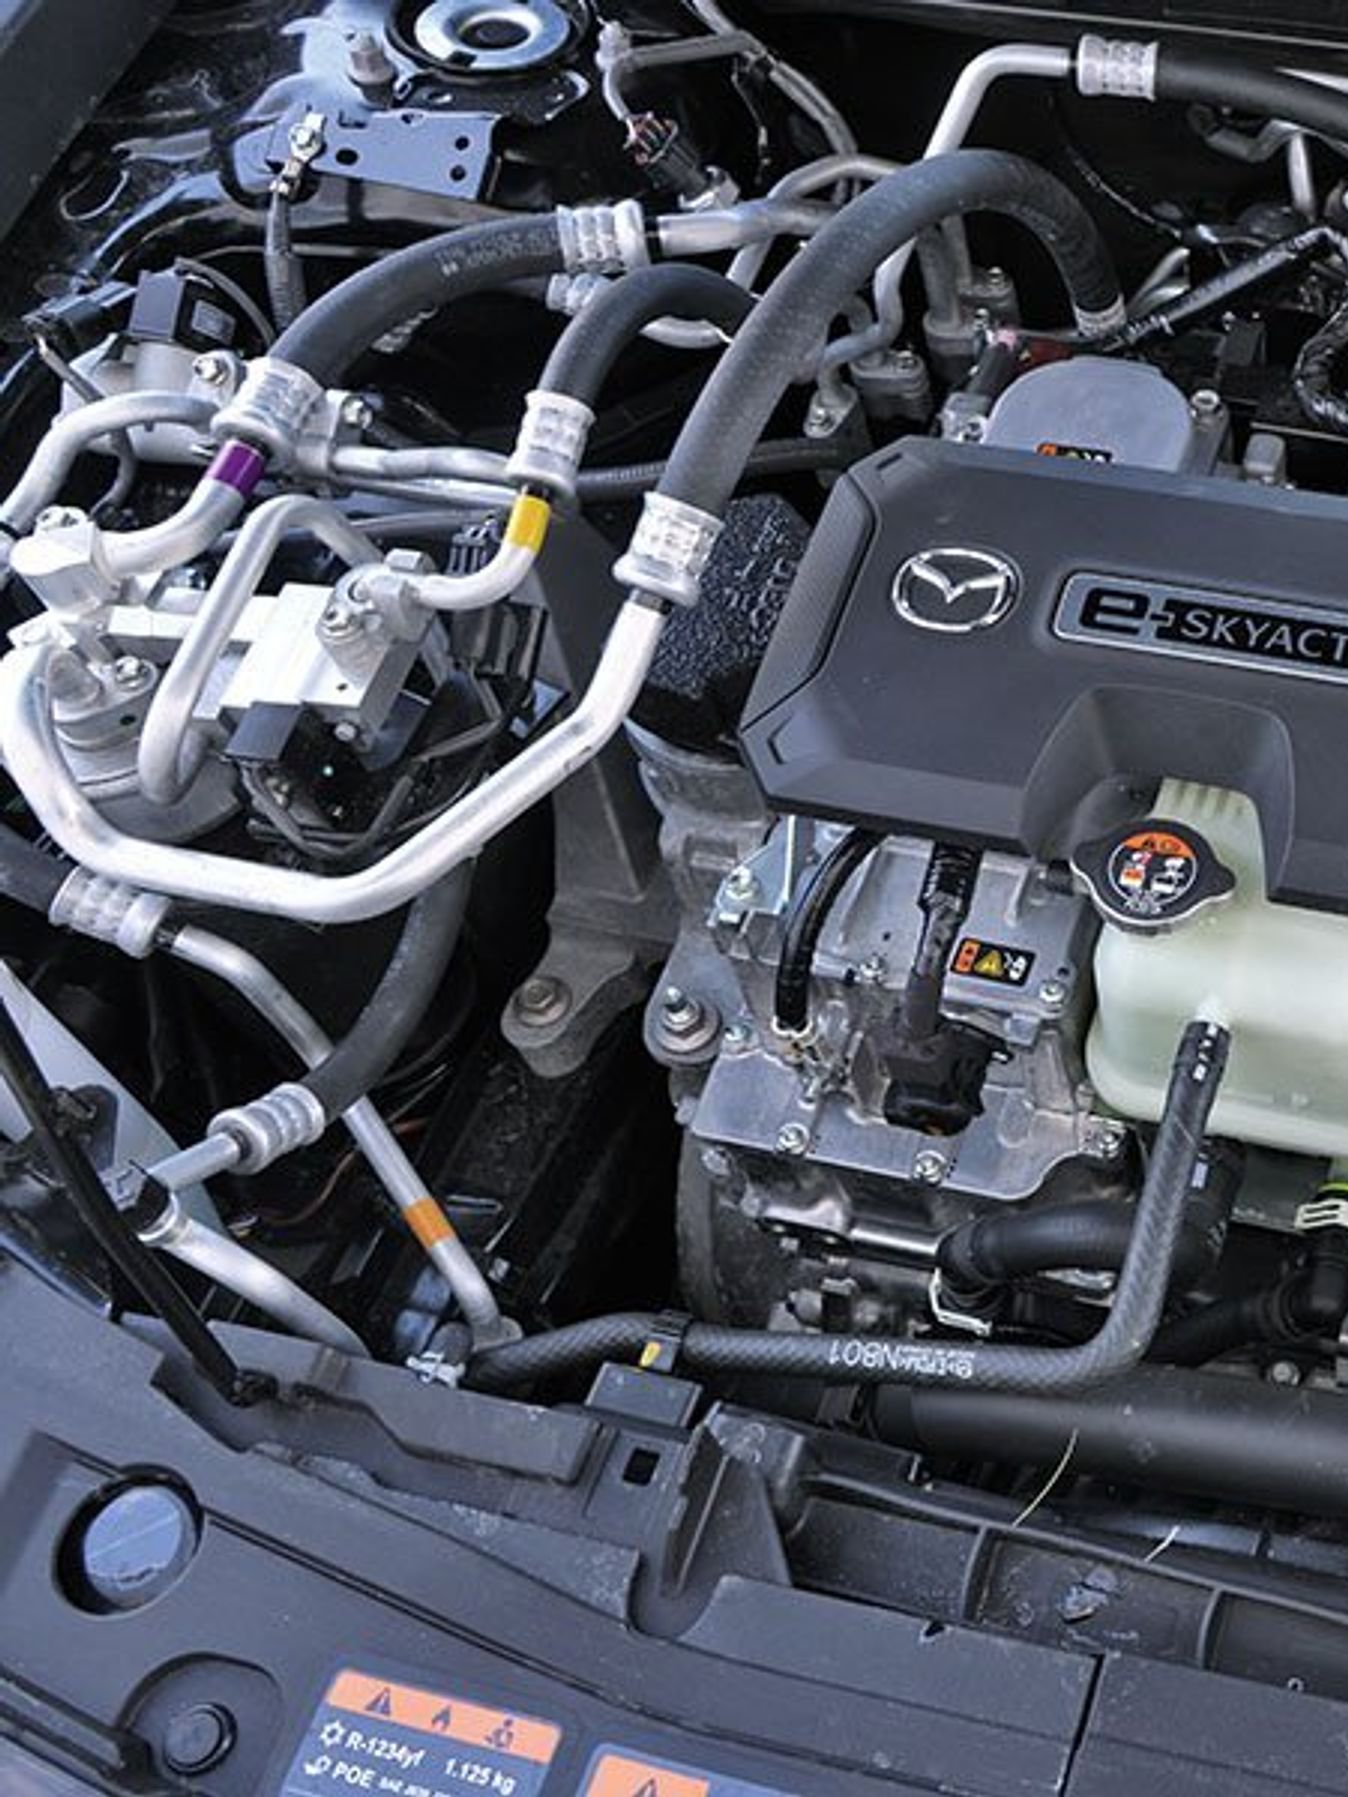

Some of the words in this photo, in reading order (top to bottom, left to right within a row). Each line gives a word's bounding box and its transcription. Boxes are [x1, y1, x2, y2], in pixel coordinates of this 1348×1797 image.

[332, 1761, 376, 1789] POE
[345, 1731, 426, 1768] R-1234yf
[445, 1758, 491, 1786] 1.125
[491, 1771, 516, 1796] kg
